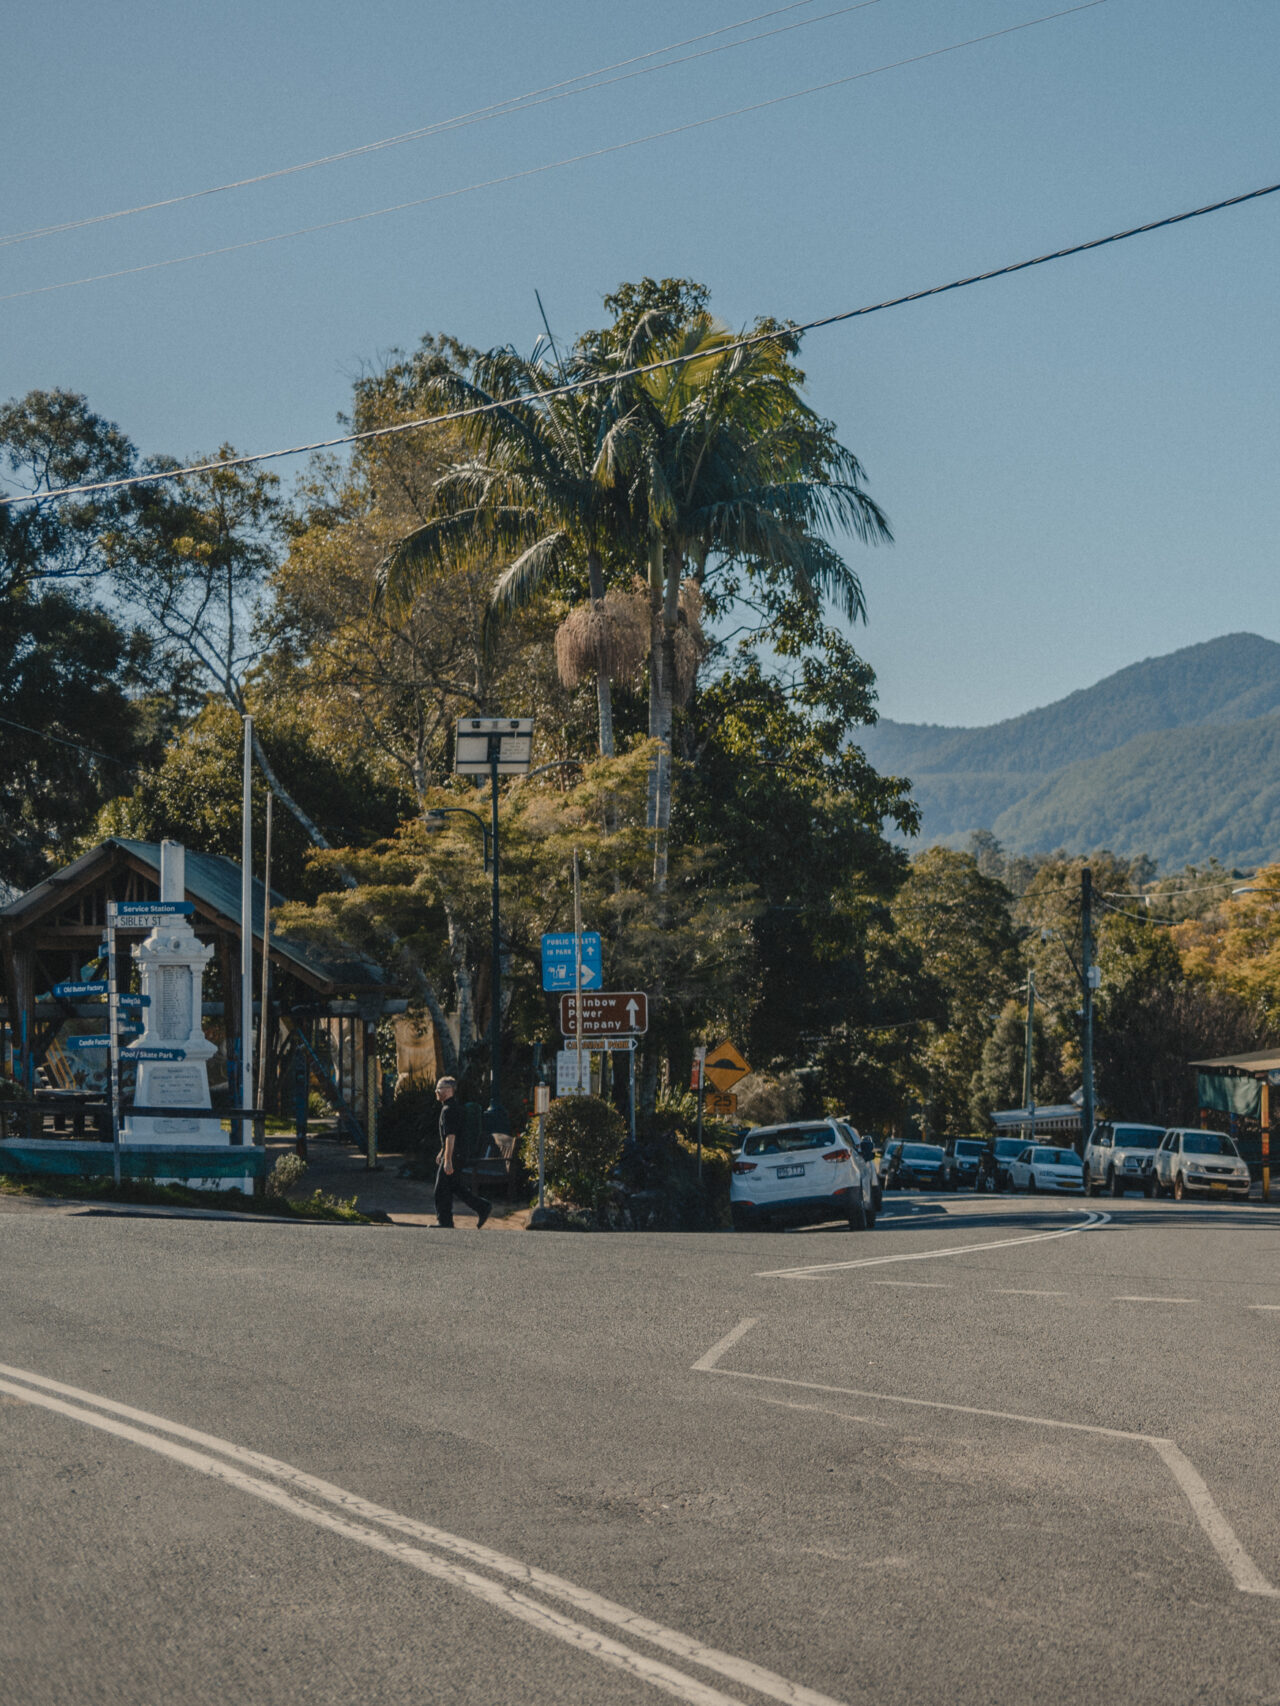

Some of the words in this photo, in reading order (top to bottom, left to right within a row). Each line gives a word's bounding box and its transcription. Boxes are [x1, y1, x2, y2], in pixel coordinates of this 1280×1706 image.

[123, 905, 149, 913] Service
[120, 916, 149, 926] SIBLEY
[152, 916, 162, 926] ST
[571, 937, 597, 945] TLETS
[87, 984, 104, 992] Factory
[568, 999, 617, 1008] Rinbow
[568, 1009, 603, 1018] Pwer
[568, 1021, 622, 1030] Cmpany
[566, 1041, 605, 1050] CAAVAN
[607, 1041, 630, 1049] PARK
[714, 1096, 732, 1106] 25
